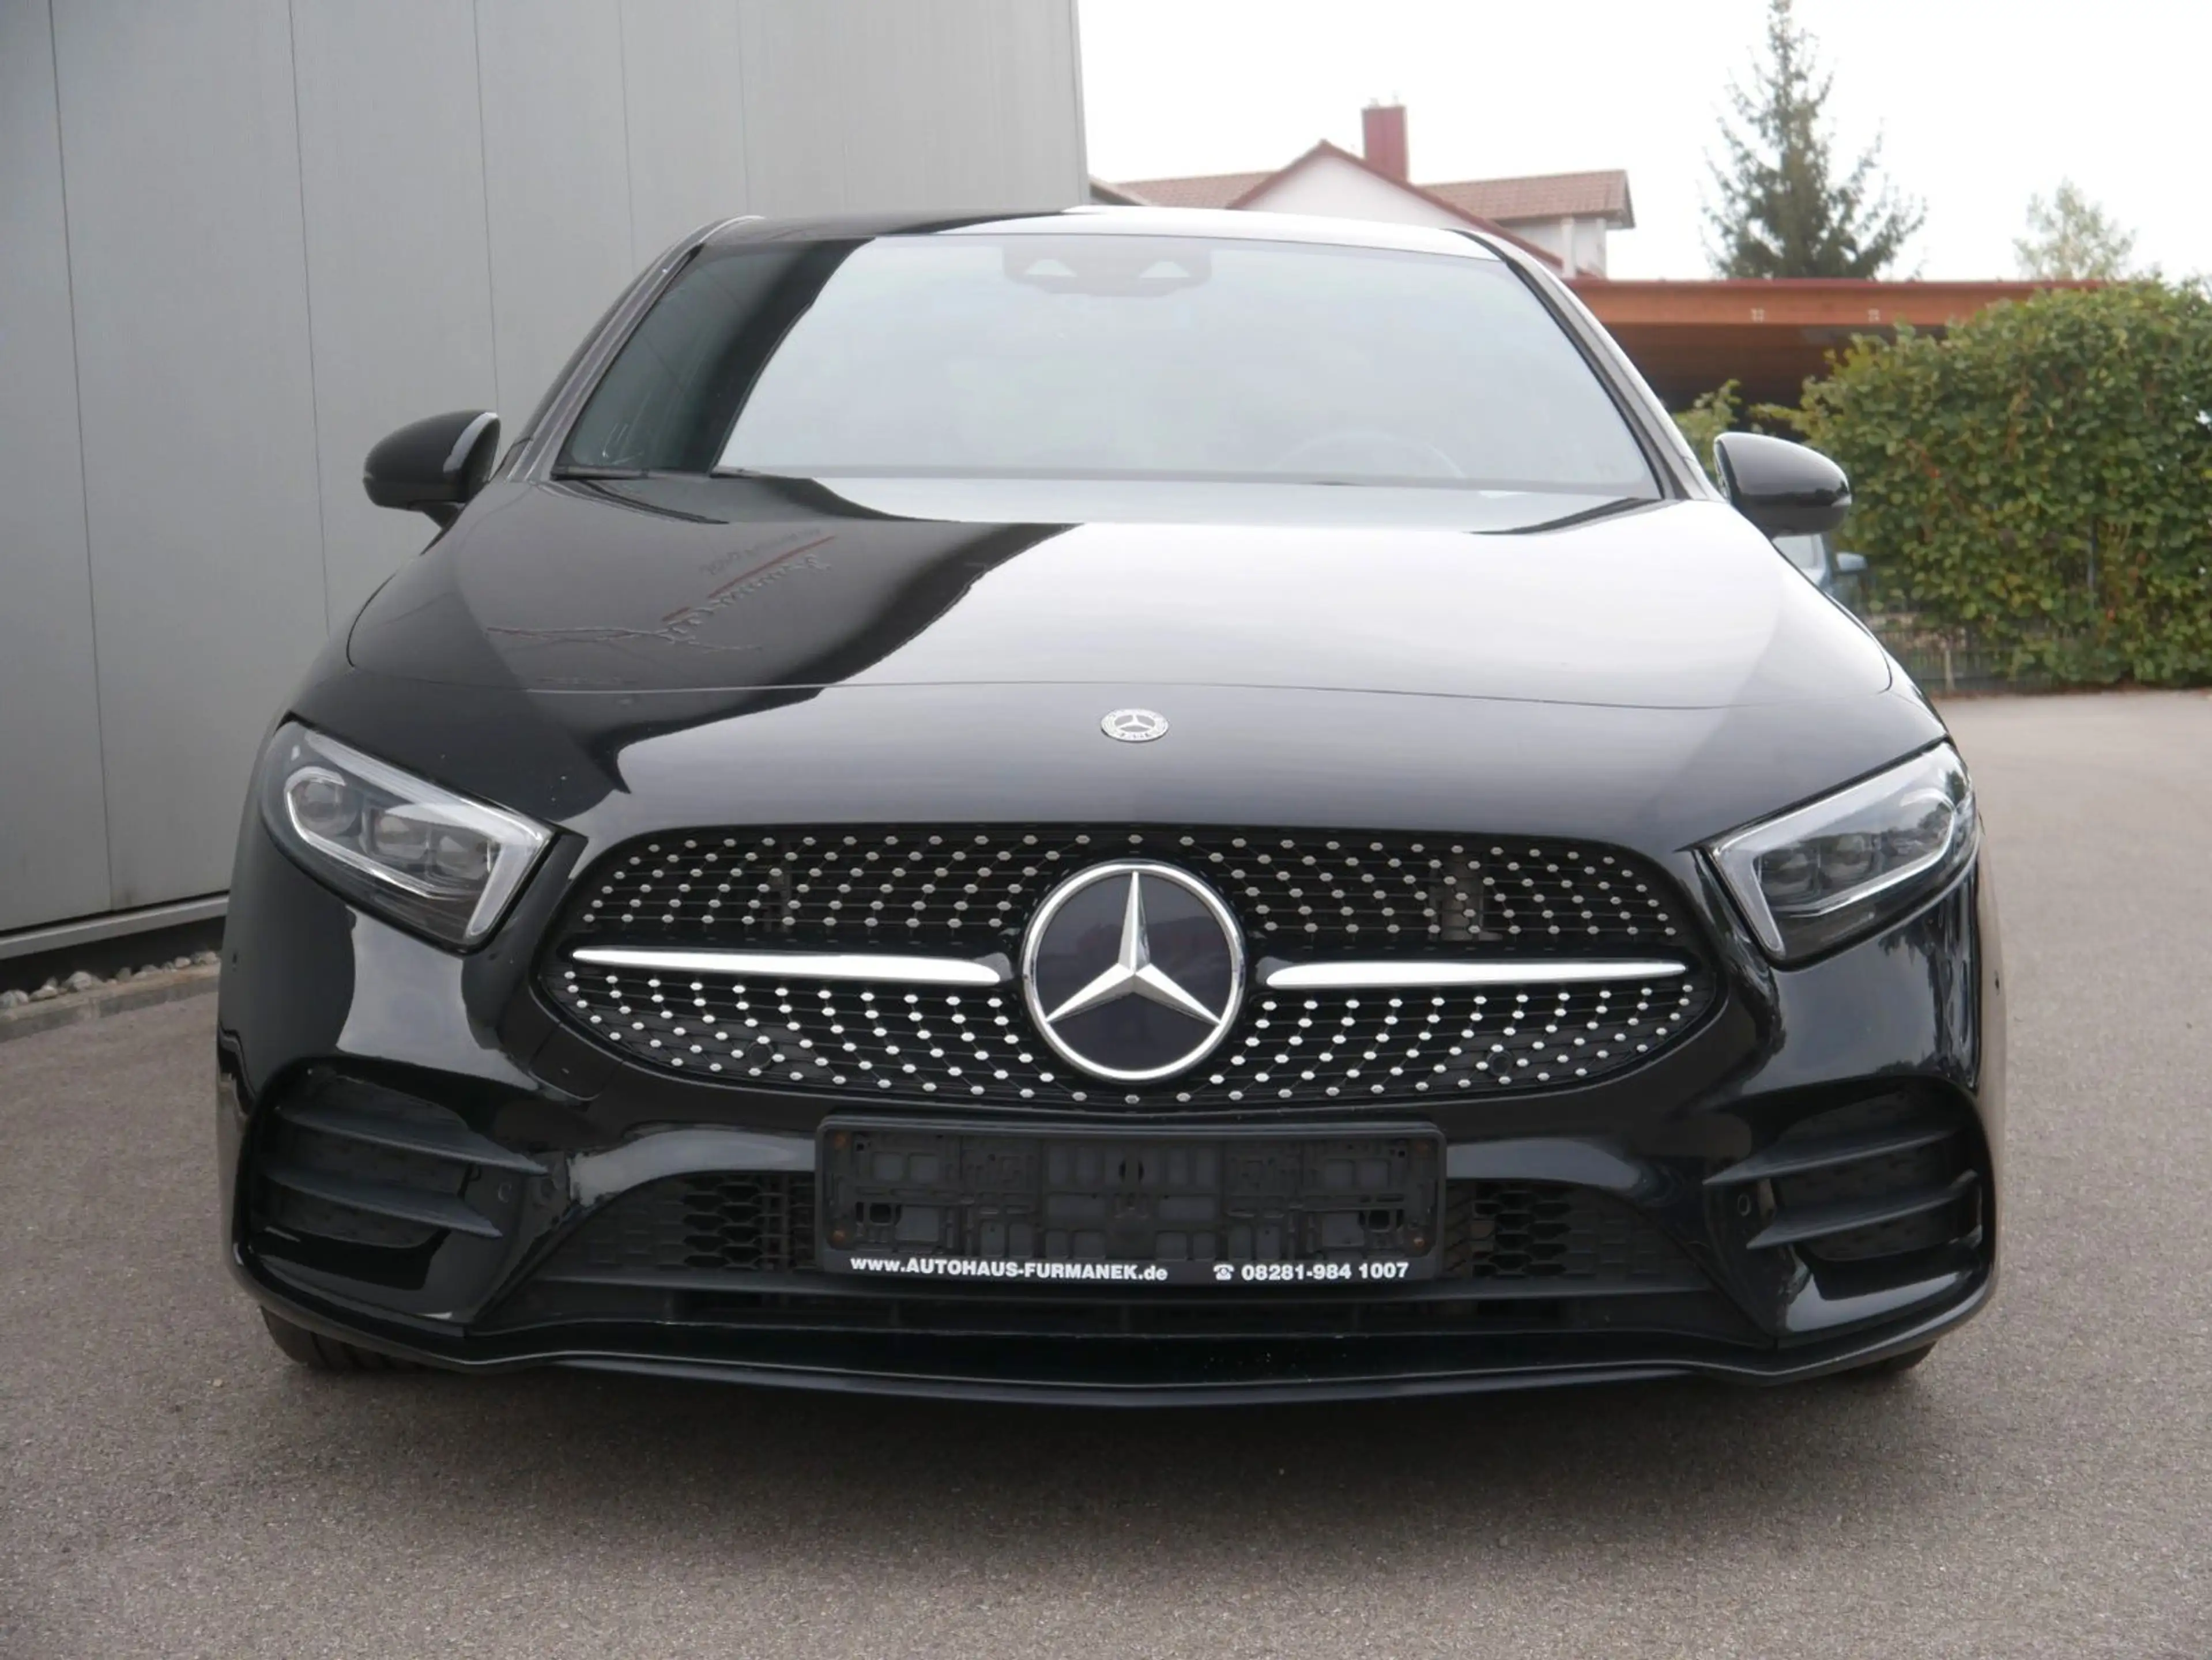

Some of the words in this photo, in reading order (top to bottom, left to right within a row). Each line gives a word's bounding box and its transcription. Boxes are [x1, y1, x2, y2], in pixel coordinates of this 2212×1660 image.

[850, 1257, 1169, 1281] www.AUTOHAUS-FURMANEK.de
[1241, 1263, 1352, 1281] 08281-984
[1358, 1261, 1410, 1279] 1007
